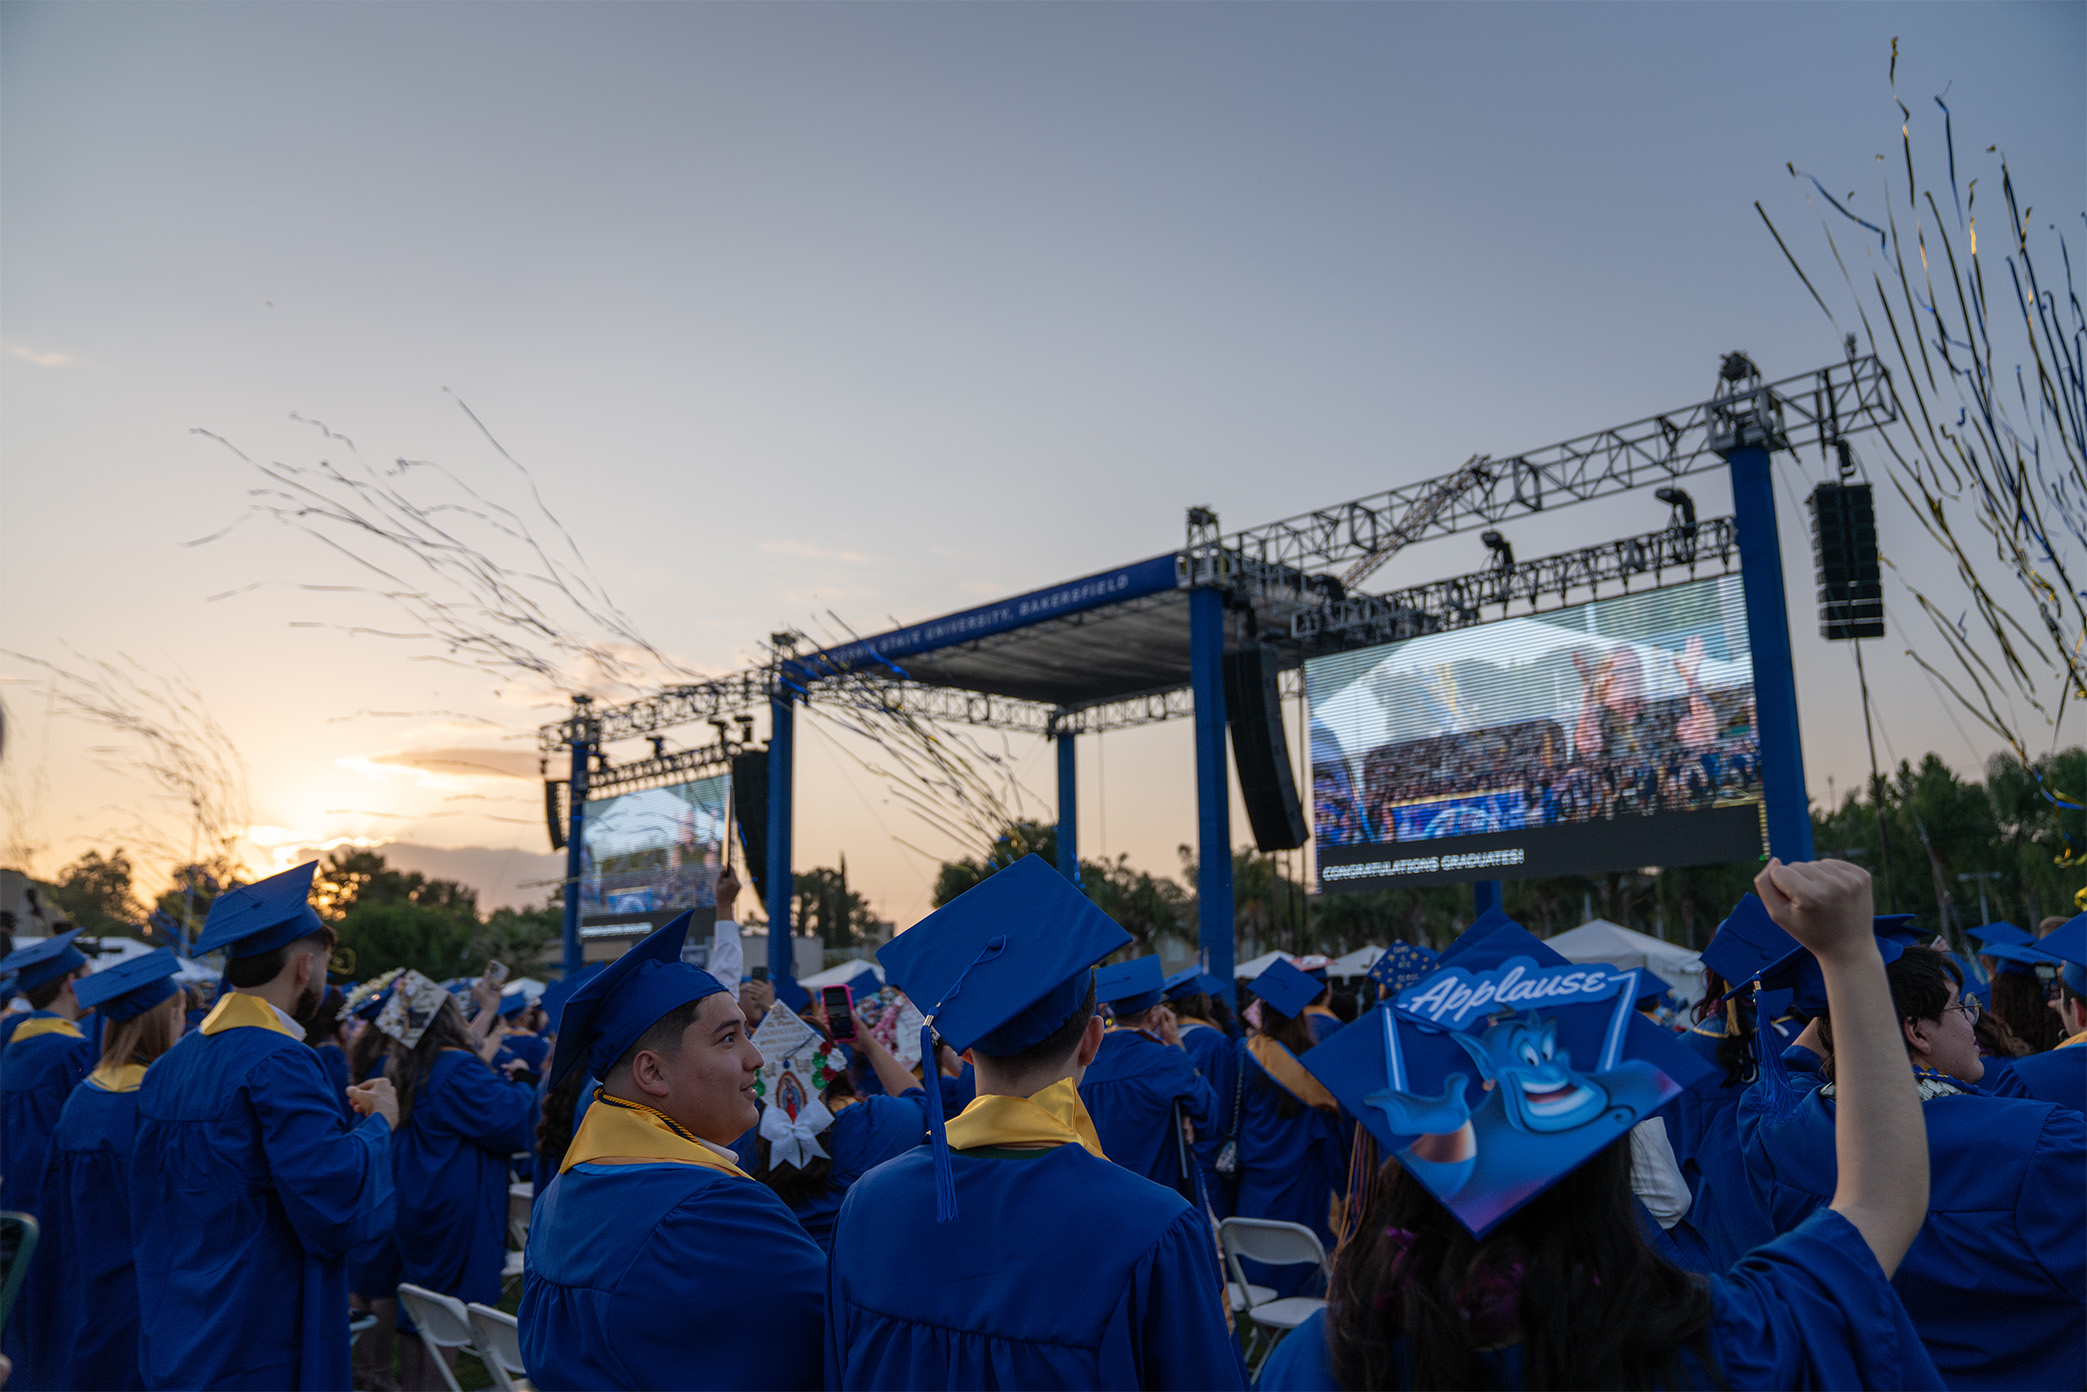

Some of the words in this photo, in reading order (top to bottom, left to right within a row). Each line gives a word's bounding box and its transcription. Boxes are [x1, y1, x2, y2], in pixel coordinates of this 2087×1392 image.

[880, 630, 921, 652] STATE
[1018, 574, 1129, 616] BAKERSFIELD
[1322, 856, 1439, 881] CONGRATULATIONS
[1440, 848, 1525, 871] GRADUATES!
[1409, 965, 1606, 1022] Applause
